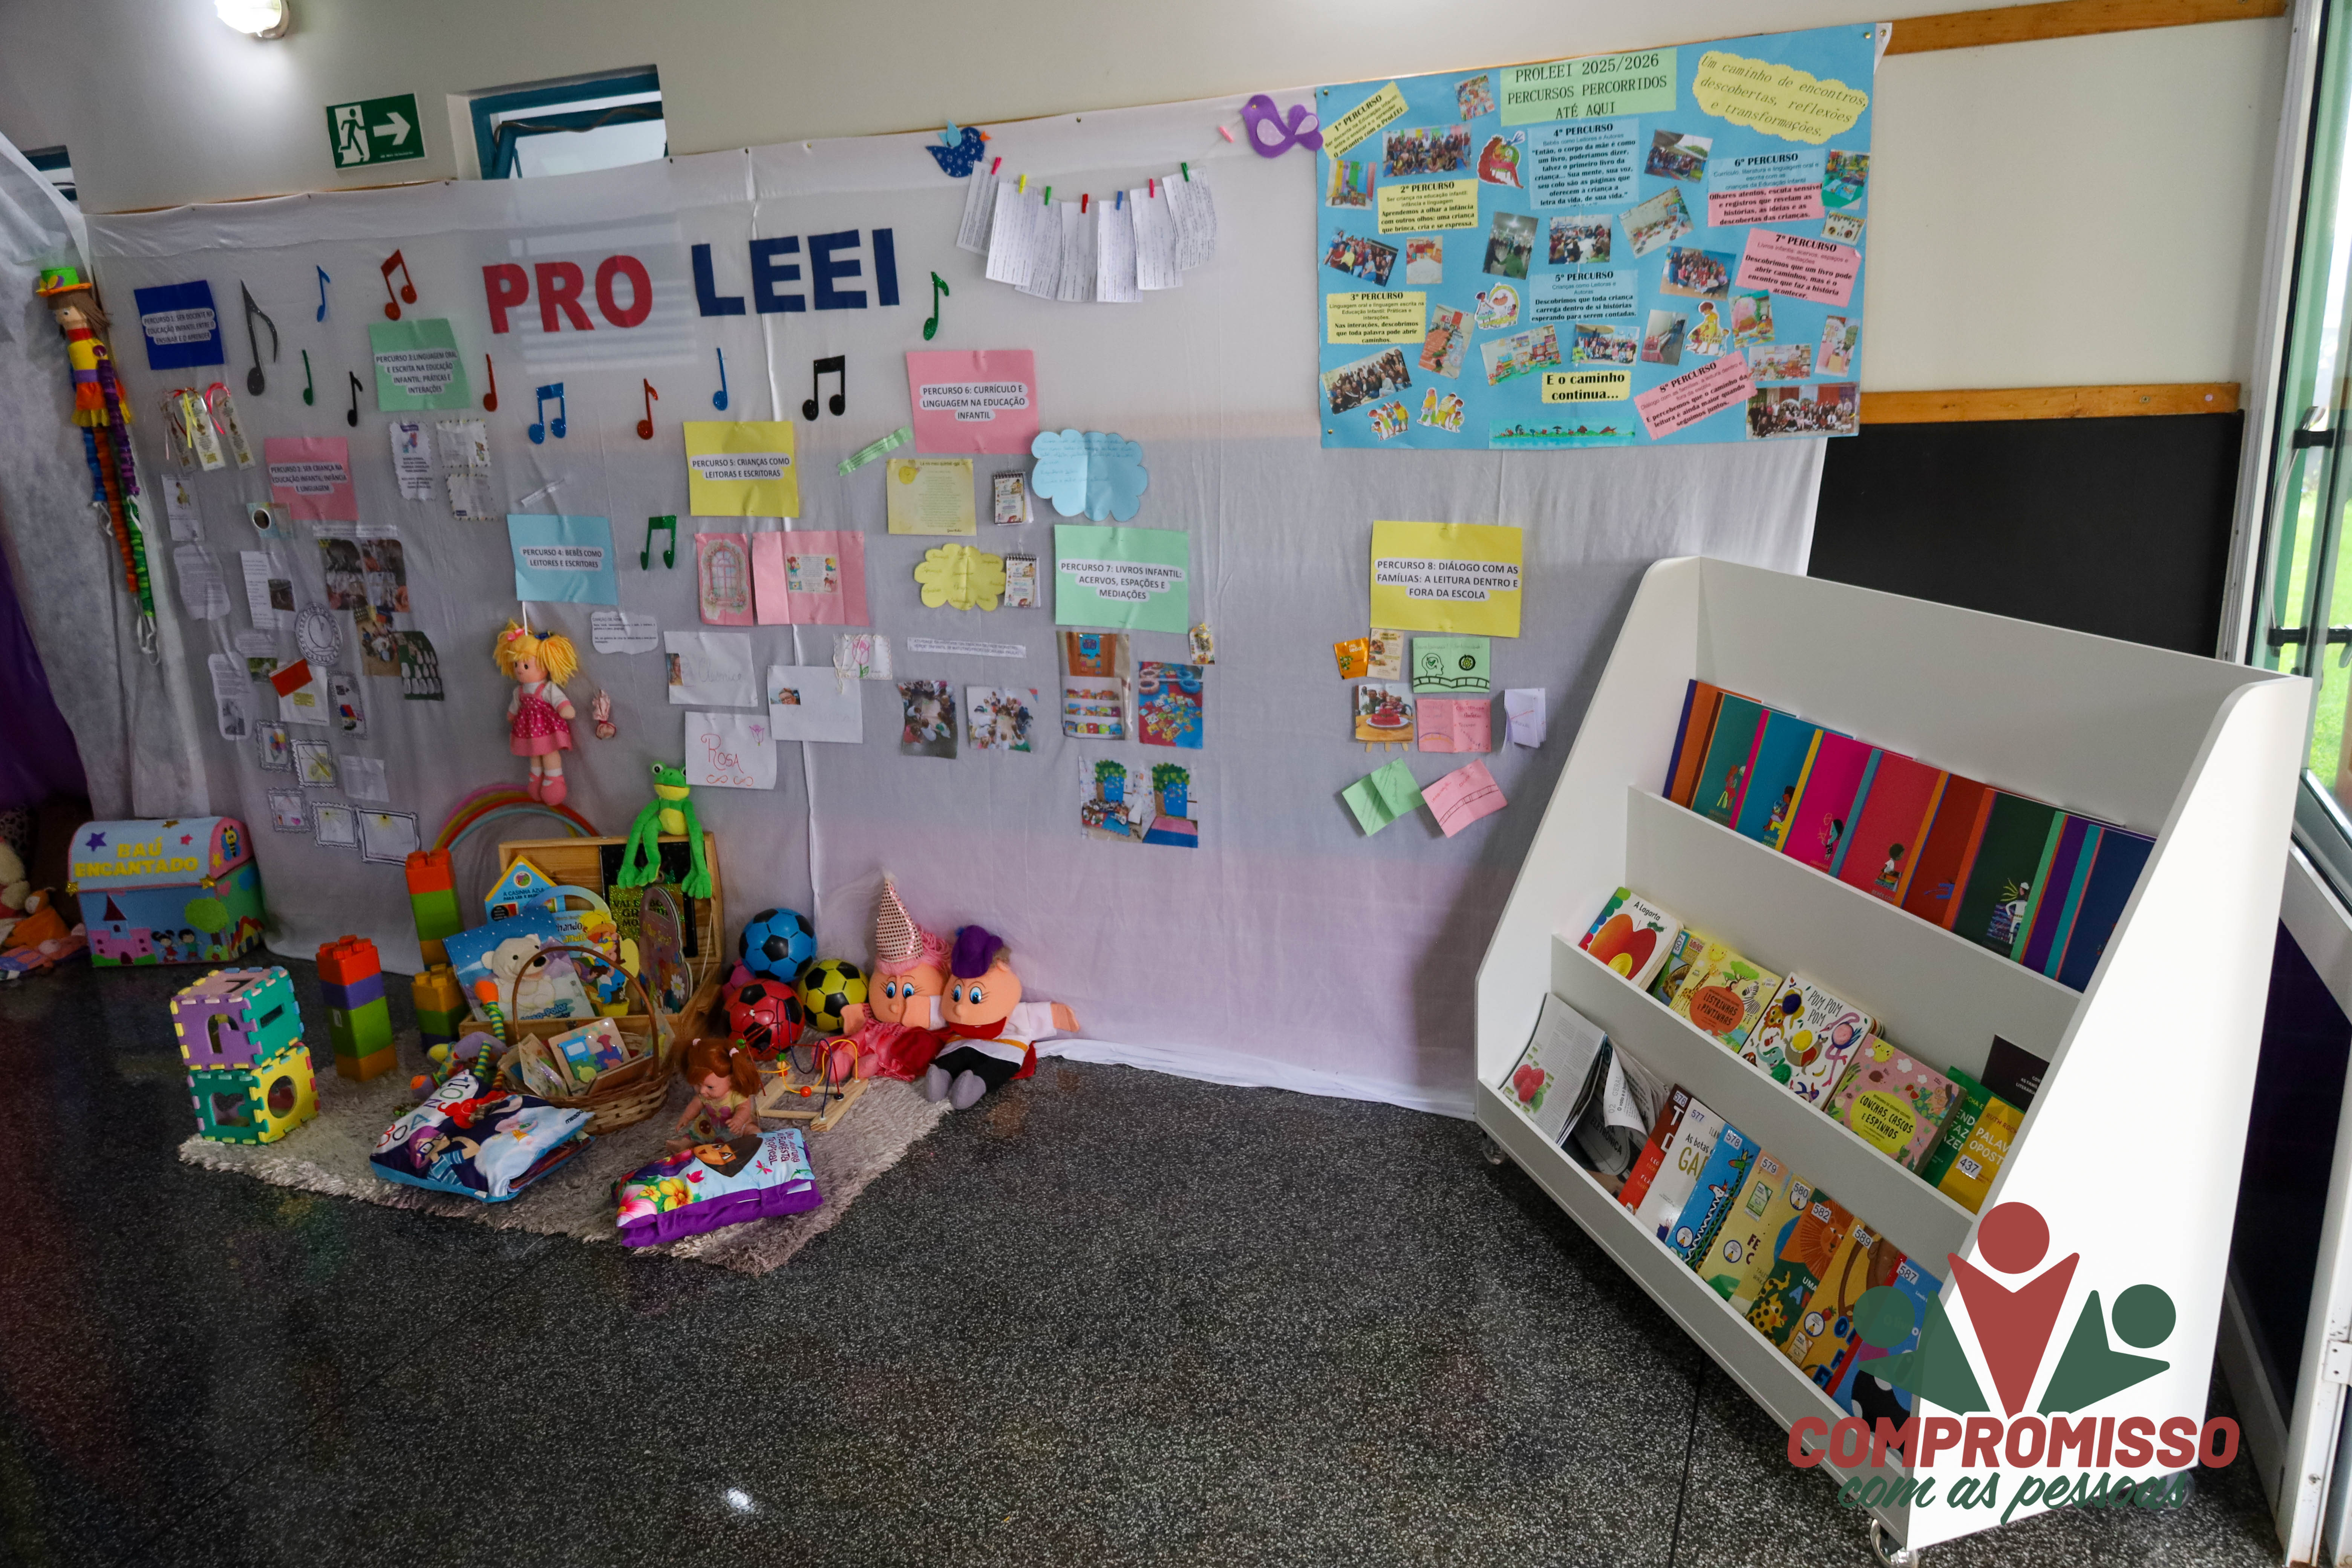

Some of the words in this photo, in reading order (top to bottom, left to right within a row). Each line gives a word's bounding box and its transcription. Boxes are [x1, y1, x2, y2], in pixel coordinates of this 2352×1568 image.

[1516, 63, 1571, 83] PROLEEI
[1582, 53, 1658, 75] 2025/2026
[1698, 55, 1717, 69] Um
[1722, 65, 1772, 81] caminho
[1778, 76, 1793, 87] de
[1799, 84, 1871, 107] encontros,
[1508, 86, 1574, 104] PERCURSOS
[1582, 75, 1666, 96] PERCORRIDOS
[1700, 77, 1776, 106] descobertas,
[1788, 101, 1851, 122] reflexões
[1343, 95, 1381, 125] PERCURSO
[1556, 103, 1578, 119] ATÉ
[1586, 101, 1614, 116] AQUI
[1725, 104, 1821, 136] transformações.
[1566, 124, 1613, 135] PERCURSO
[1748, 153, 1798, 165] PERCURSO
[1412, 182, 1454, 192] PERCURSO
[1787, 236, 1836, 252] PERCURSO
[482, 254, 653, 334] PRO
[691, 228, 899, 317] LEEI
[1567, 271, 1613, 281] PERCURSO
[426, 361, 453, 371] EDUCAÇÃO
[1547, 375, 1553, 384] E
[1570, 372, 1625, 384] caminho
[1671, 362, 1716, 387] PERCURSO
[408, 384, 442, 394] INTERAÇÕES
[974, 384, 1016, 394] CURRÍCULO
[1552, 389, 1618, 400] continua...
[983, 396, 1025, 407] EDUCAÇÃO
[737, 458, 767, 467] CRIANÇAS
[565, 548, 583, 556] BEBÊS
[1061, 563, 1104, 571] PERCURSO
[1116, 566, 1143, 574] LIVROS
[1145, 568, 1181, 578] INFANTIL:
[1378, 561, 1425, 569] PERCURSO
[1439, 561, 1479, 571] DIÁLOGO
[1482, 564, 1504, 573] COM
[1079, 576, 1118, 586] ACERVOS,
[1121, 578, 1159, 588] ESPAÇÕES
[1377, 573, 1421, 582] FAMÍLIAS:
[1434, 576, 1470, 585] LEITURA
[1473, 577, 1510, 587] DENTRO
[1099, 589, 1146, 600] MEDIAÇÕES
[1409, 588, 1433, 596] FORA
[1452, 590, 1485, 599] ESCOLA
[117, 836, 163, 858] BAÚ
[74, 856, 199, 877] ENCANTADO
[1639, 903, 1661, 921] Lagarta
[1674, 934, 1684, 951] 507
[1704, 992, 1738, 1016] LISTRINHAS
[1808, 990, 1825, 1010] POM
[1825, 997, 1842, 1017] POM
[1701, 1004, 1733, 1026] PINTINHAS
[1808, 1009, 1827, 1027] POM
[1674, 1092, 1687, 1106] 576
[1691, 1109, 1705, 1122] 577
[1860, 1095, 1888, 1120] CONCHAS,
[1888, 1113, 1914, 1134] CASCOS
[1985, 1113, 2003, 1125] RUTH
[1866, 1114, 1899, 1139] ESPINHOS
[1685, 1133, 1694, 1144] As
[1694, 1137, 1710, 1153] botas
[1725, 1133, 1741, 1148] 578
[1762, 1159, 1778, 1174] 579
[1960, 1158, 1979, 1173] 437
[1793, 1183, 1808, 1198] 580
[1813, 1205, 1830, 1220] 582
[1854, 1229, 1871, 1247] 589
[1899, 1265, 1917, 1282] 587
